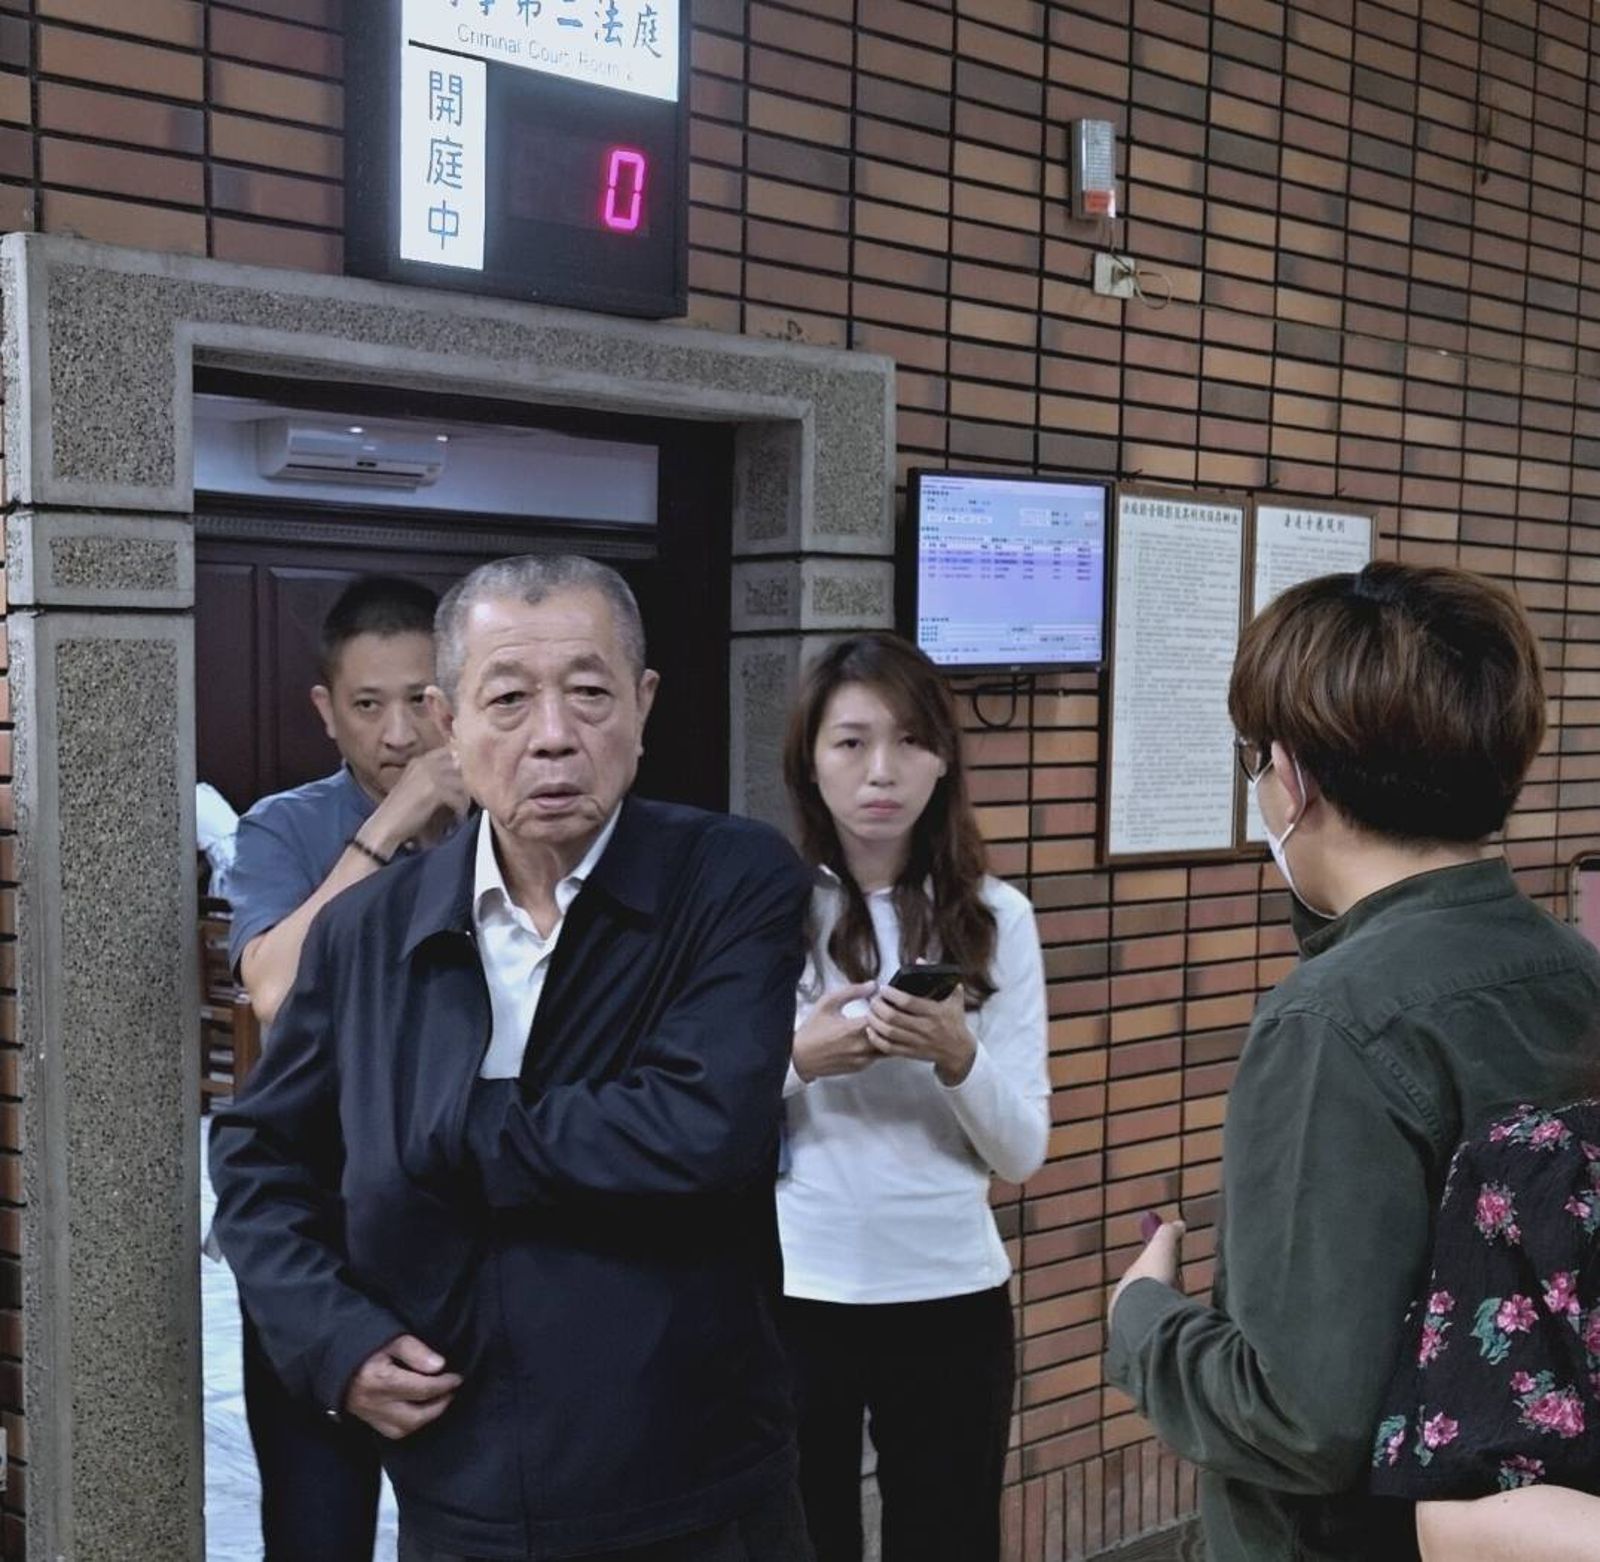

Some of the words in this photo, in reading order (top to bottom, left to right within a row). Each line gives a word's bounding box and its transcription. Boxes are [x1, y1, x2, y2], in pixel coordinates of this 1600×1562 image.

[458, 23, 521, 54] Criminal
[528, 39, 568, 66] Court
[426, 70, 464, 250] 開庭中
[604, 149, 646, 231] 0
